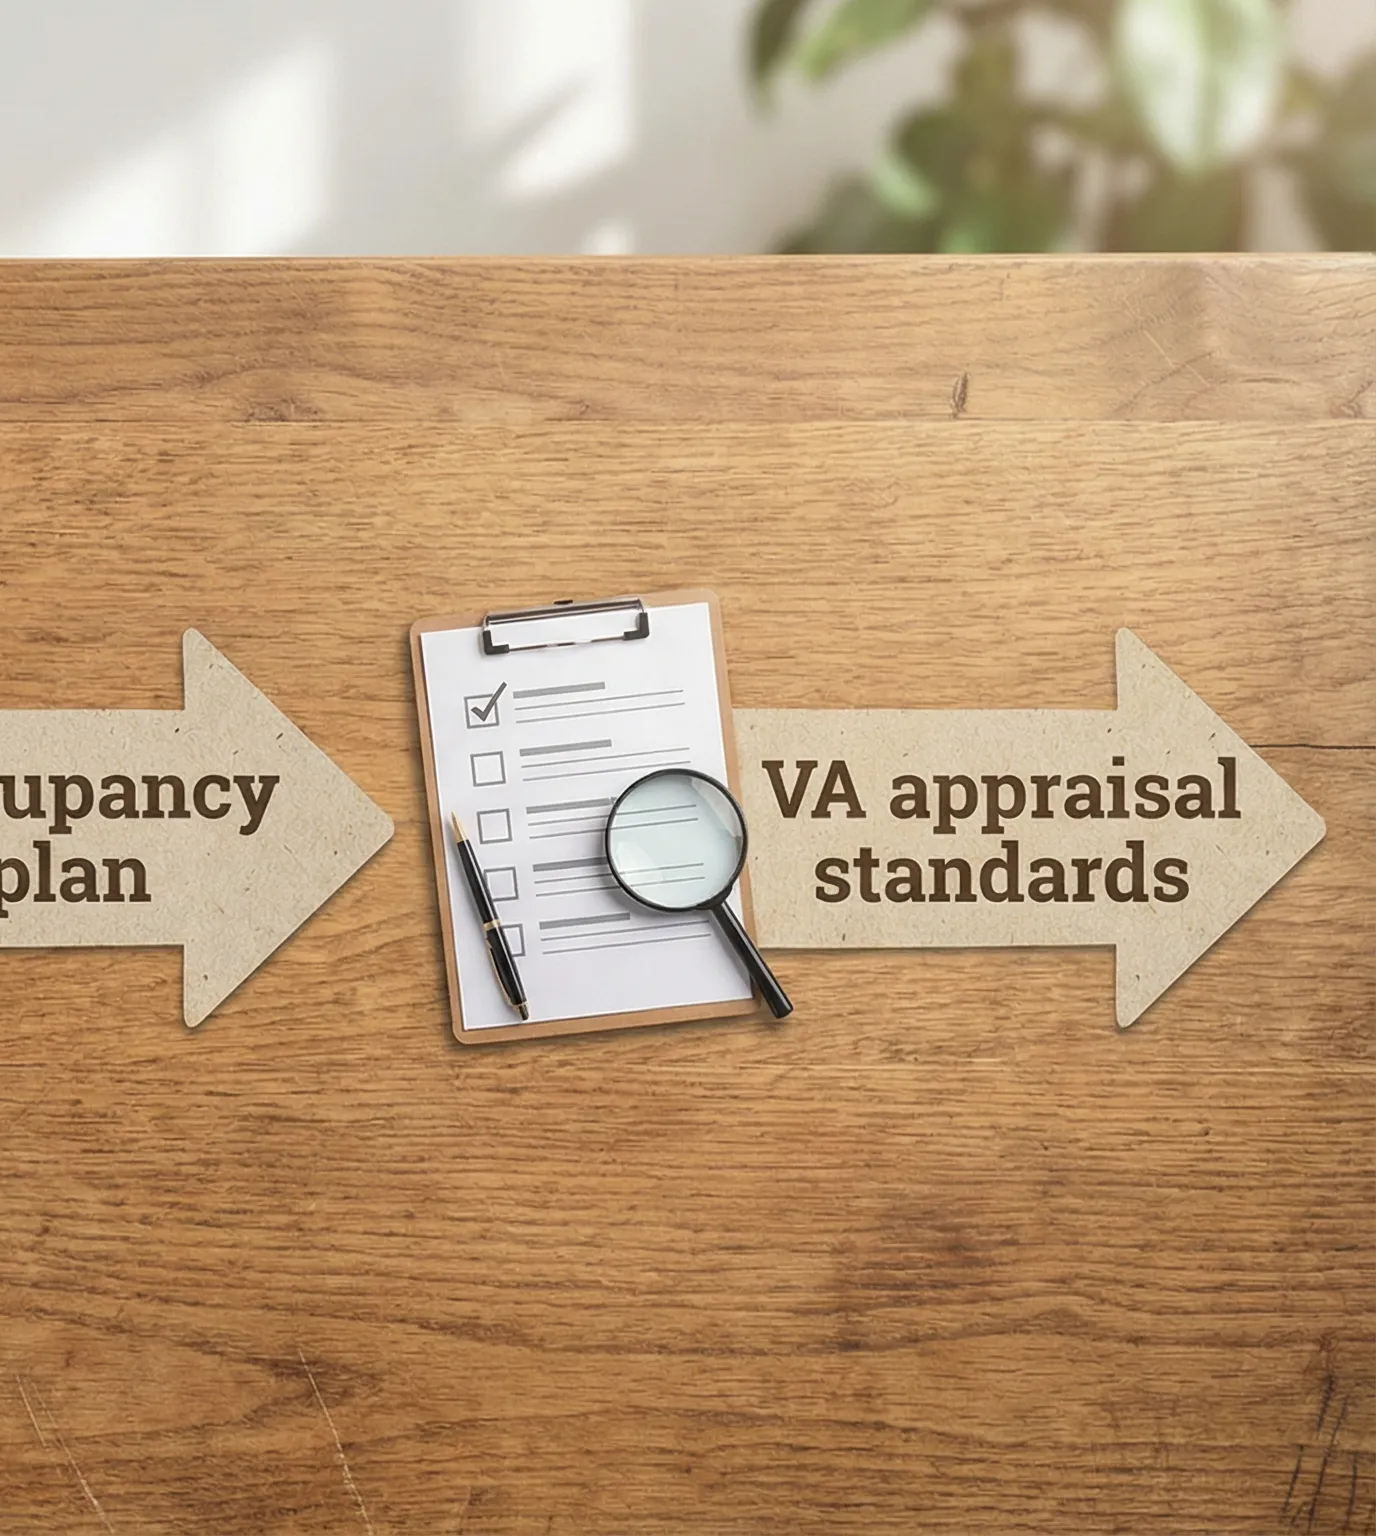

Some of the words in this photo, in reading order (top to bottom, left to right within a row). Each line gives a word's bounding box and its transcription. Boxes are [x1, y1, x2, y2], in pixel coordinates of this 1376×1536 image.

[761, 760, 867, 819] VA
[889, 756, 1242, 835] appraisal
[814, 839, 1190, 903] standards
